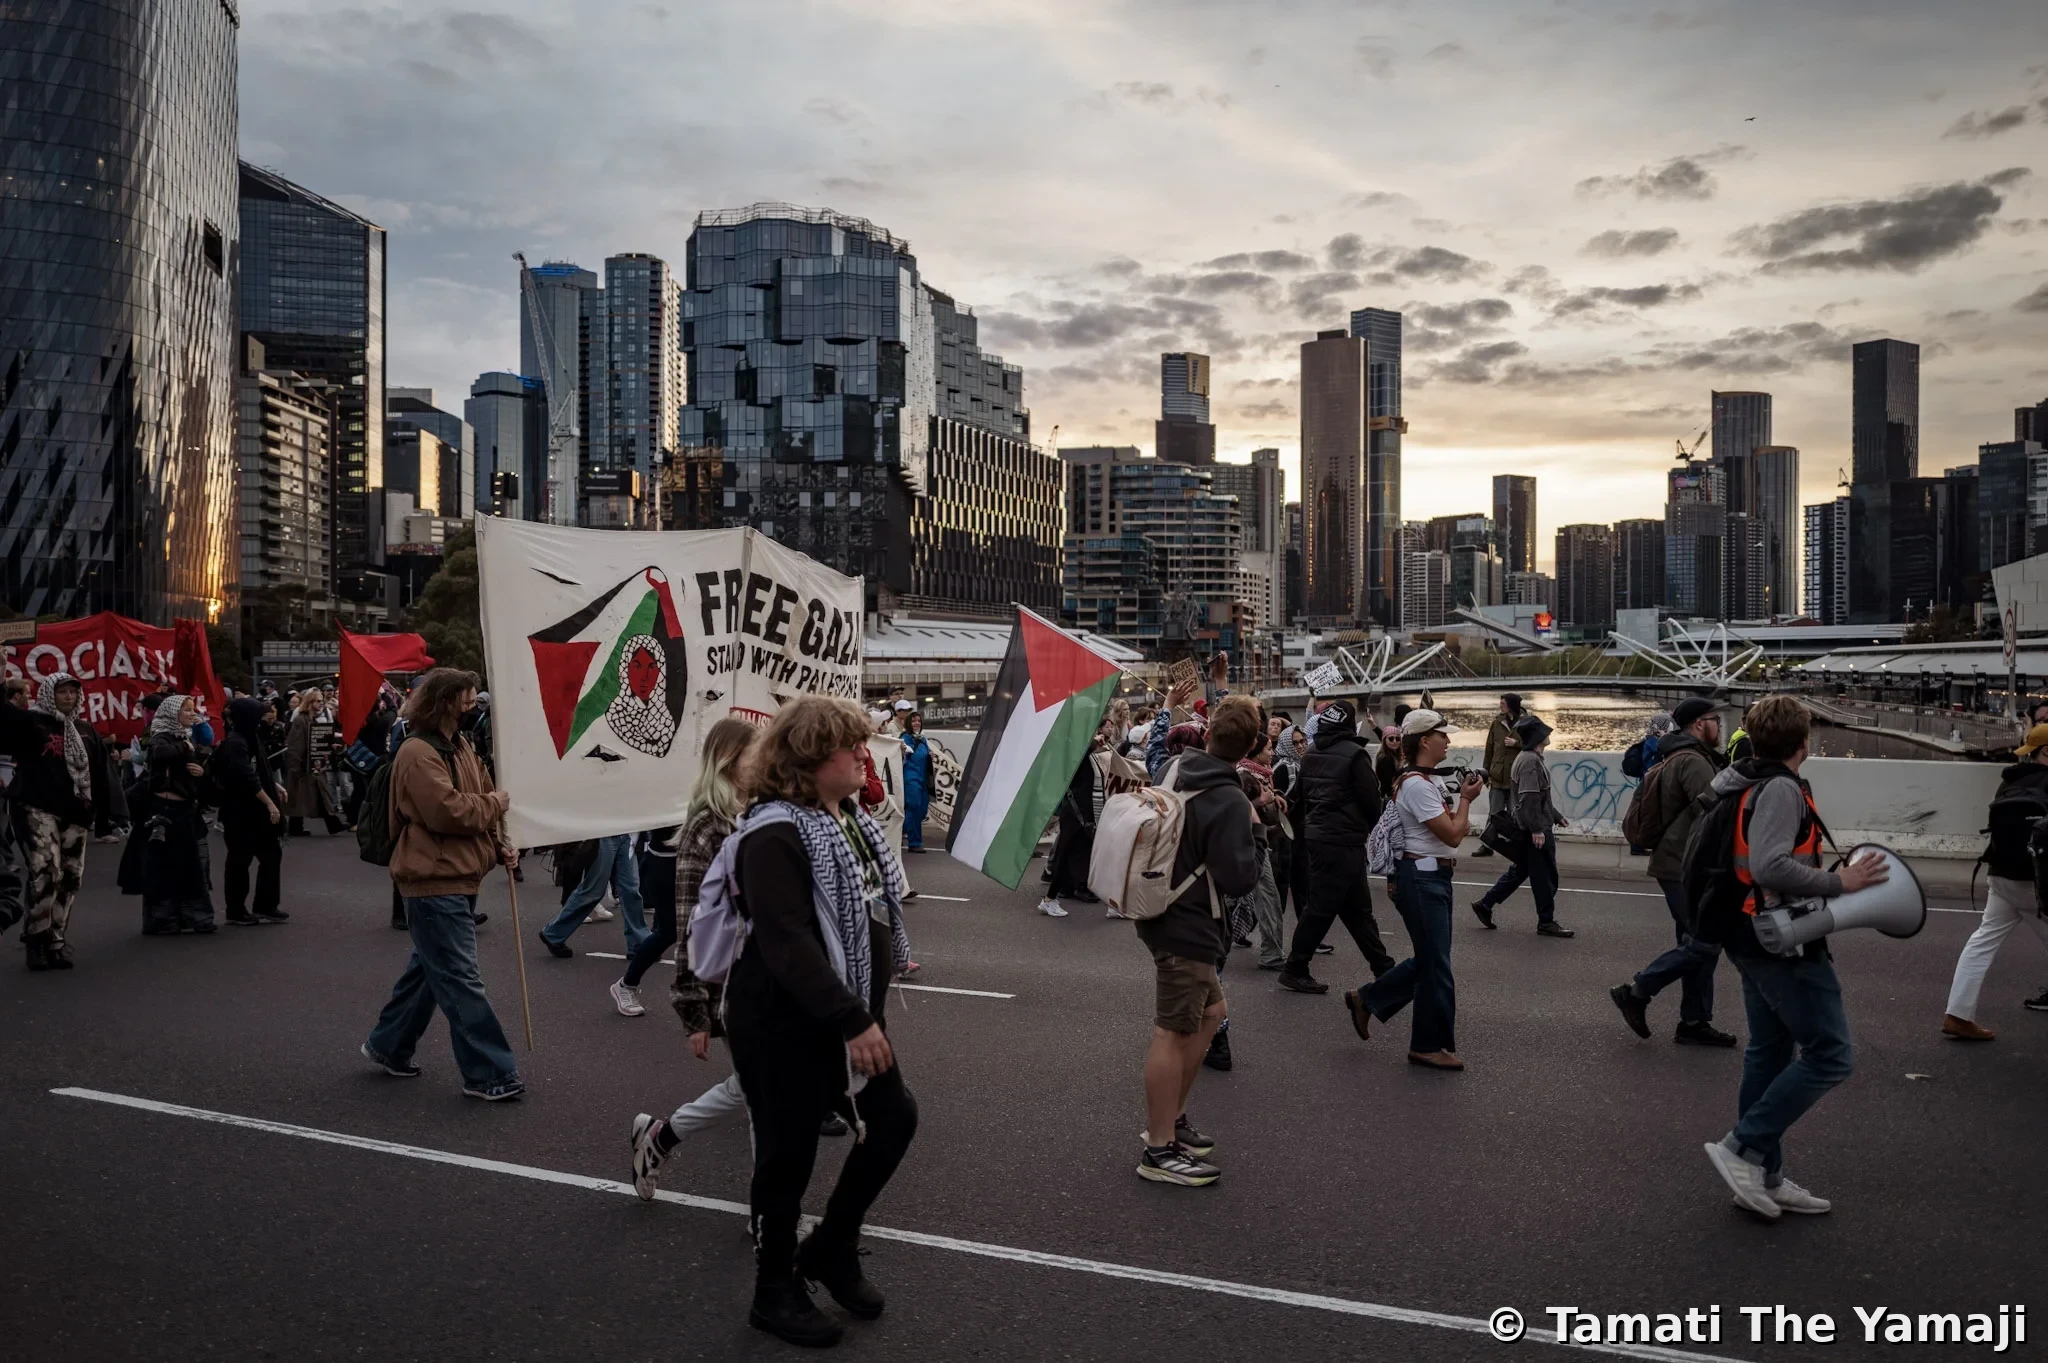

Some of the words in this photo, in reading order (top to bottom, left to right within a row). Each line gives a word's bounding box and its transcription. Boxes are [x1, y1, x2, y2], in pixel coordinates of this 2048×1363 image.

[695, 568, 799, 646] FREE
[799, 597, 859, 666] GAZA
[751, 645, 798, 684] WITH
[923, 706, 967, 720] MELBOURNE'S
[881, 756, 896, 796] A
